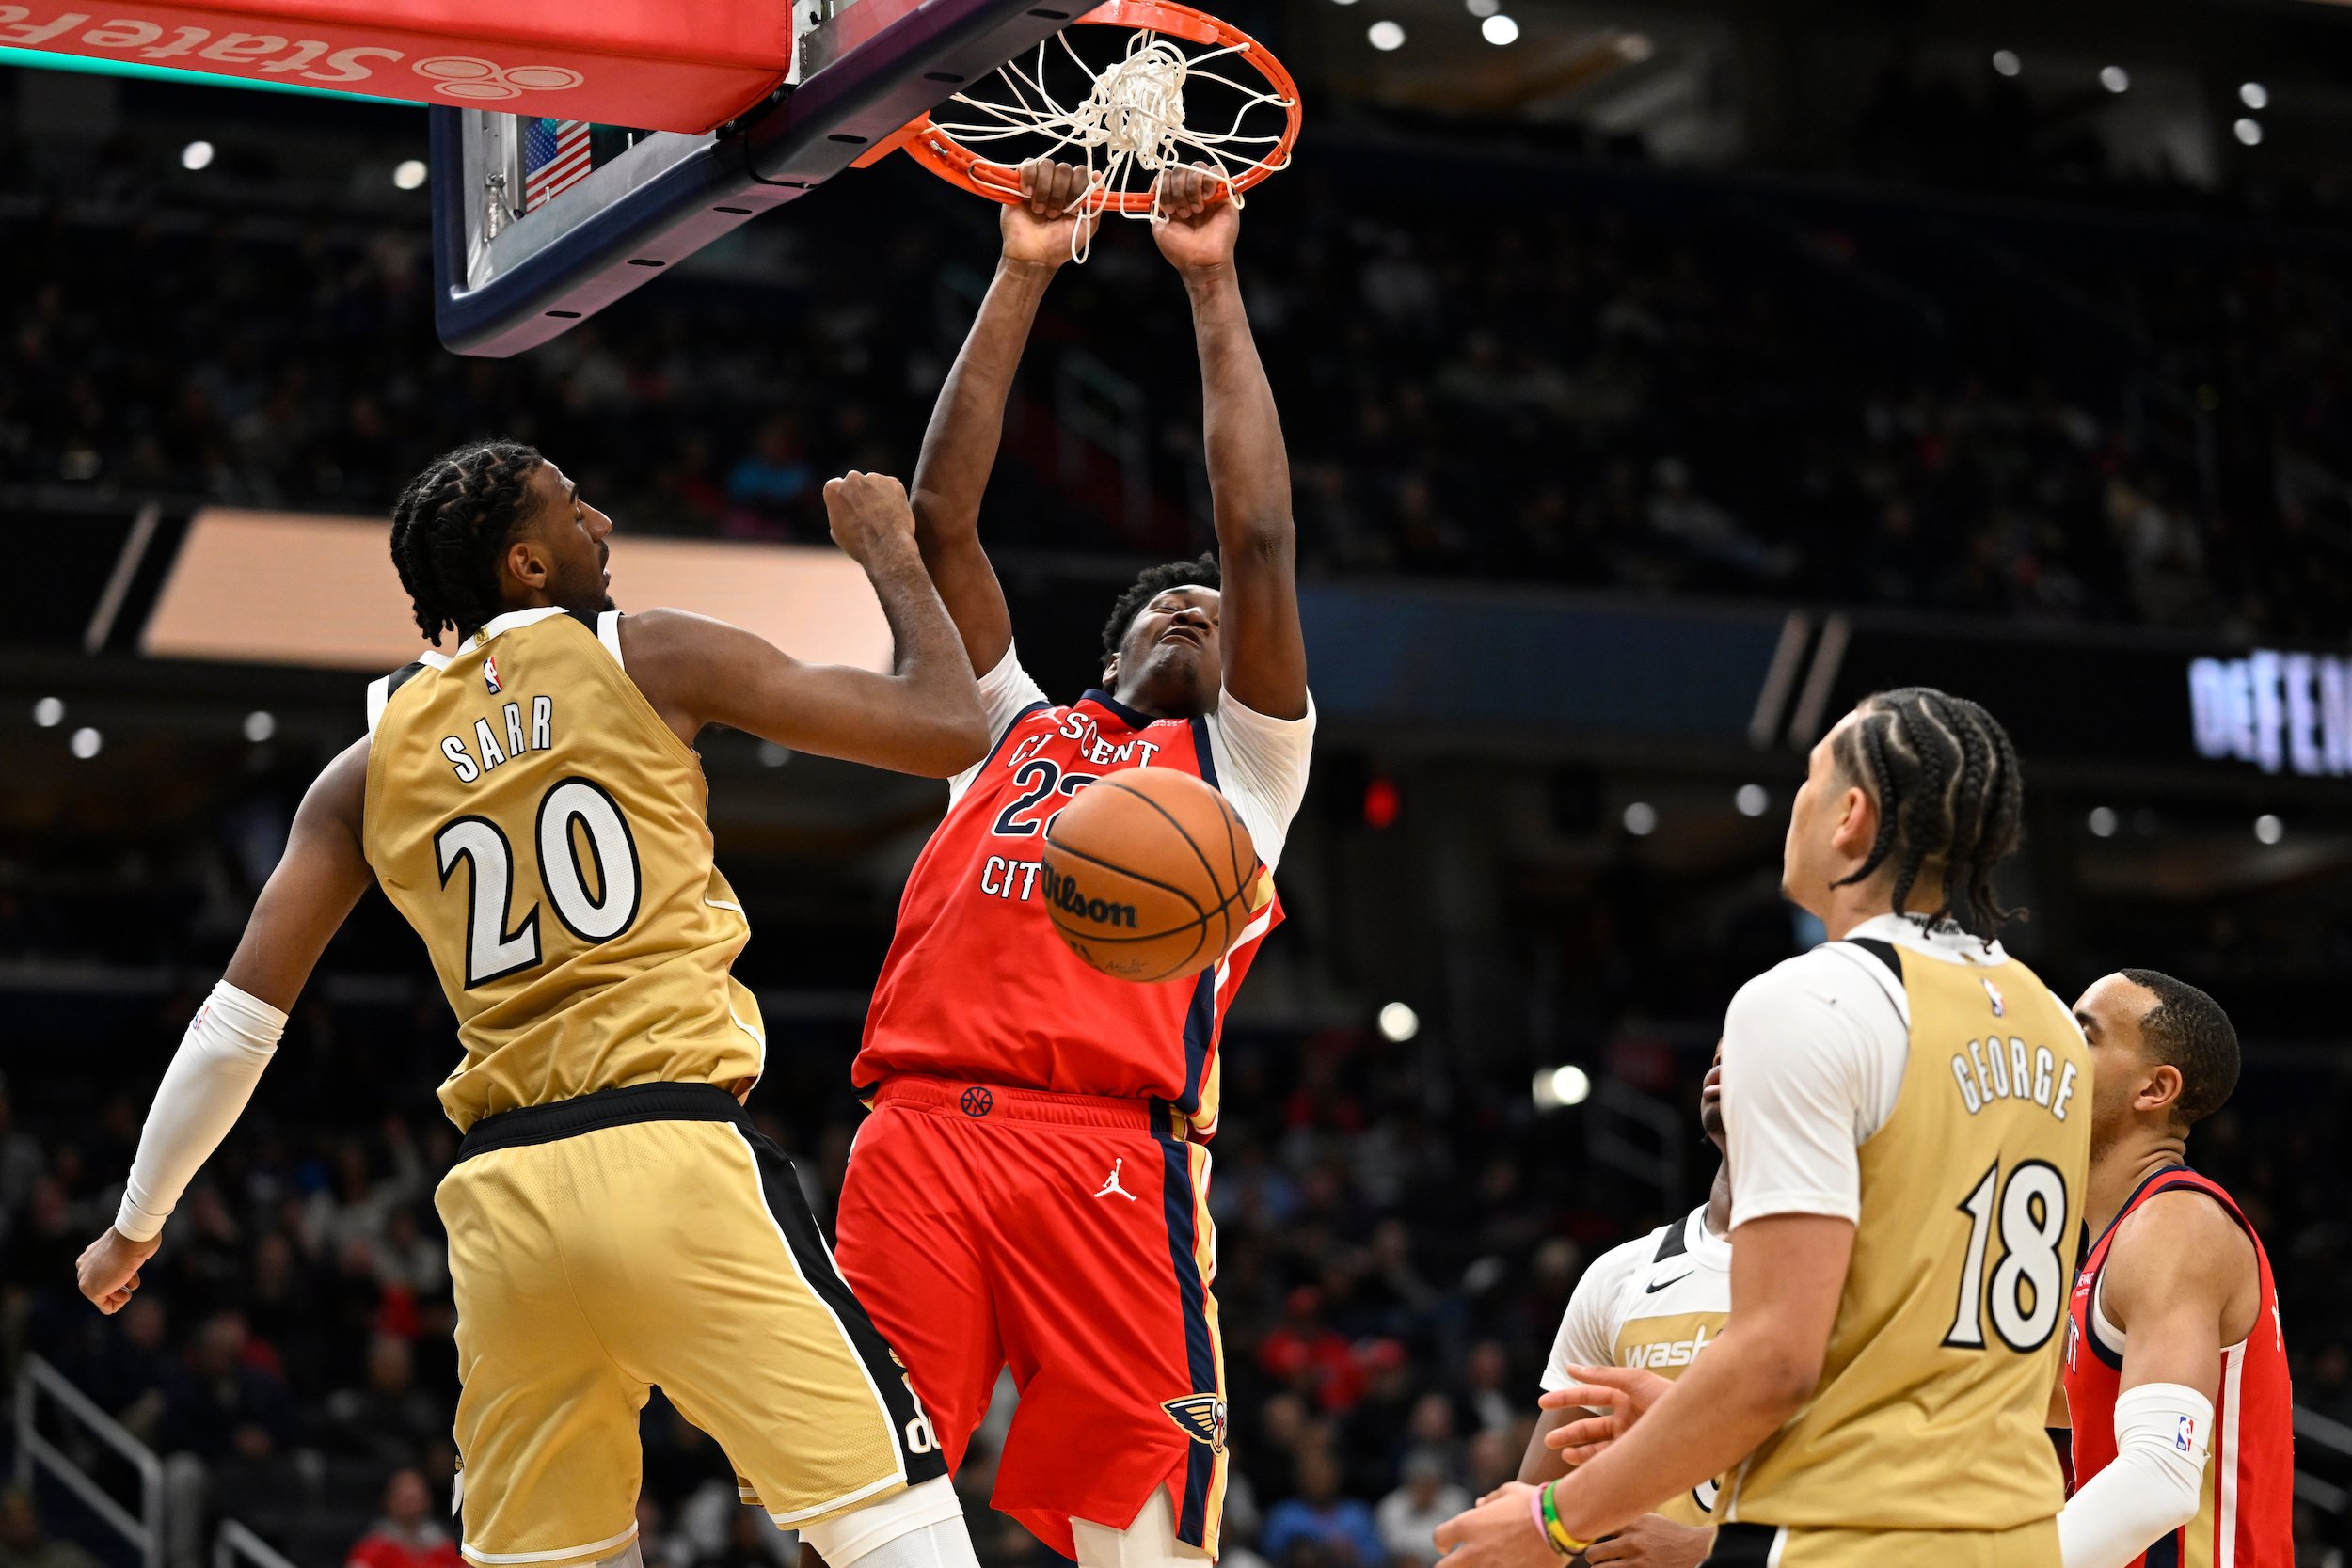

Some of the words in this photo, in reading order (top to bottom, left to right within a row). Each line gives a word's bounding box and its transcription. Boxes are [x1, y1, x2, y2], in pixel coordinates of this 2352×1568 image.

[441, 696, 552, 783] SARR
[1007, 712, 1160, 768] CSCENT
[434, 776, 642, 991] 20
[980, 854, 1042, 901] CIT
[1951, 1036, 2078, 1122] GEORGE
[1940, 1153, 2067, 1354] 18
